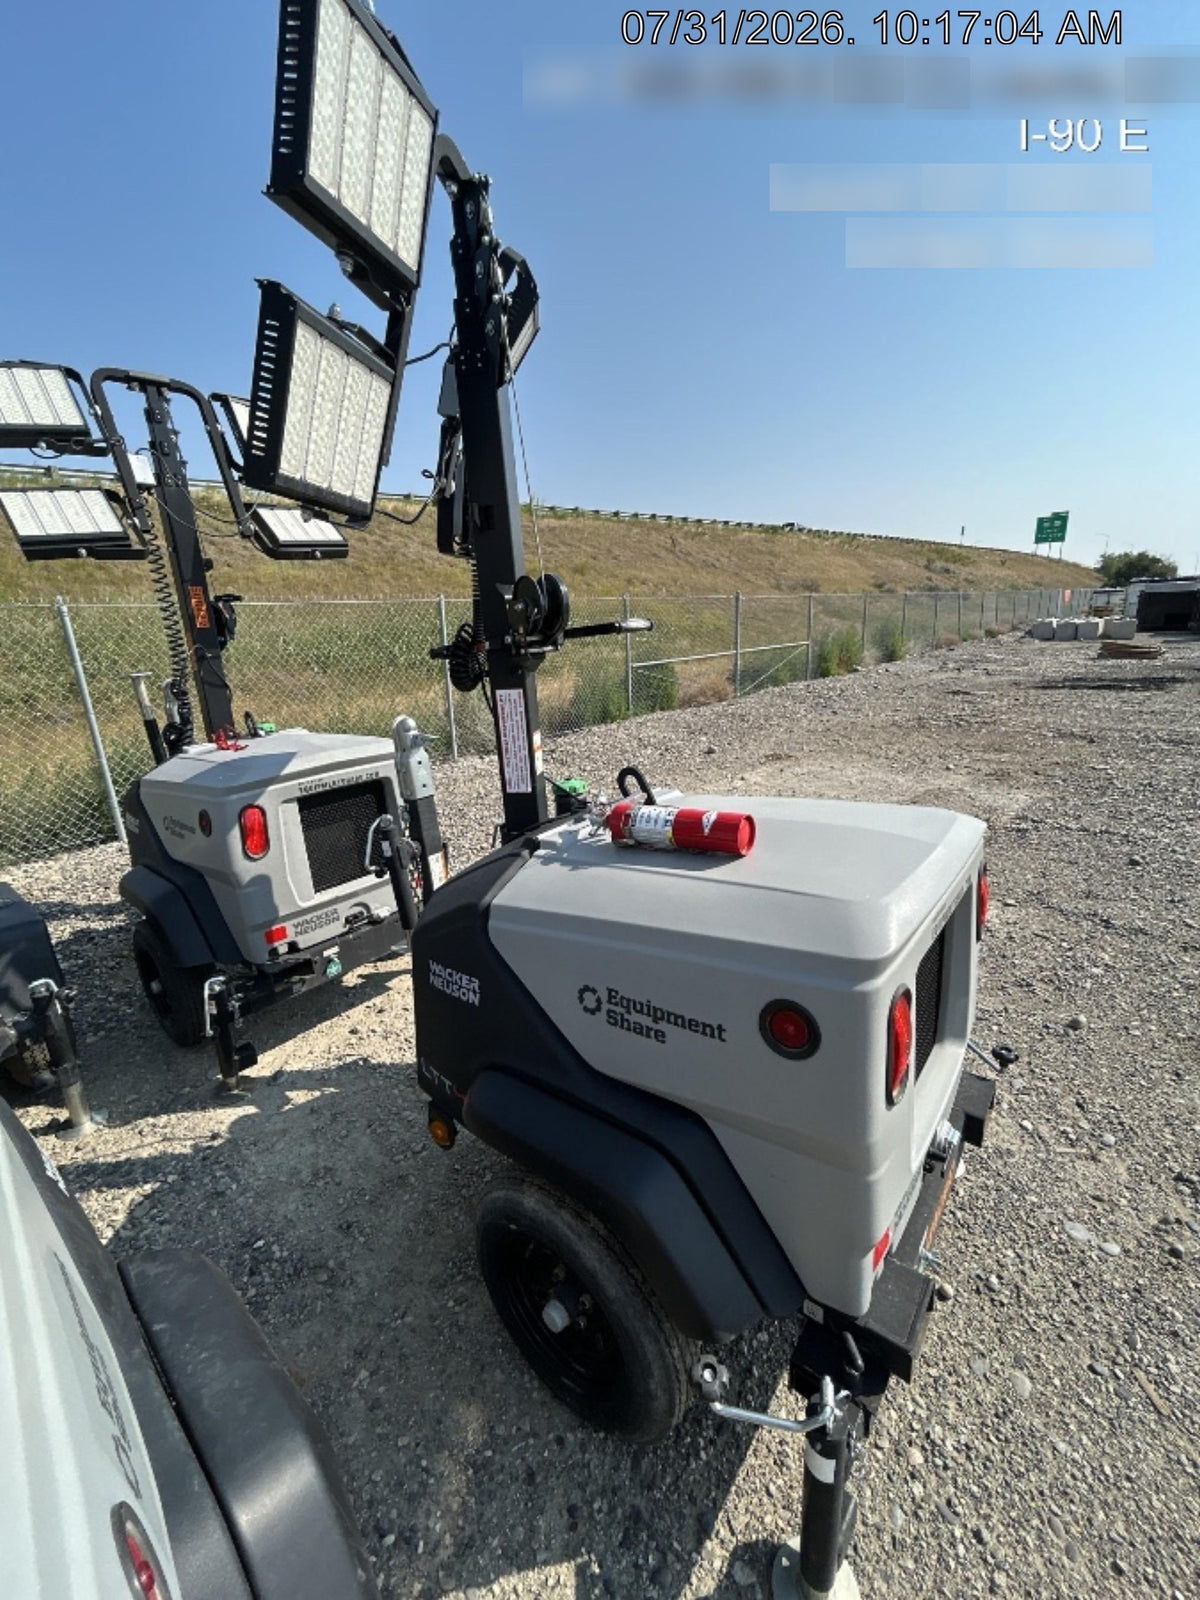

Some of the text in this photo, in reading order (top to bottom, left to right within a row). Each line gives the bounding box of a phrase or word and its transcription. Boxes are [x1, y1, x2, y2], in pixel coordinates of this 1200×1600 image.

[429, 959, 481, 992] WACKER
[429, 971, 481, 1008] NEUSON
[606, 986, 727, 1043] Equipment
[606, 1007, 667, 1044] Share
